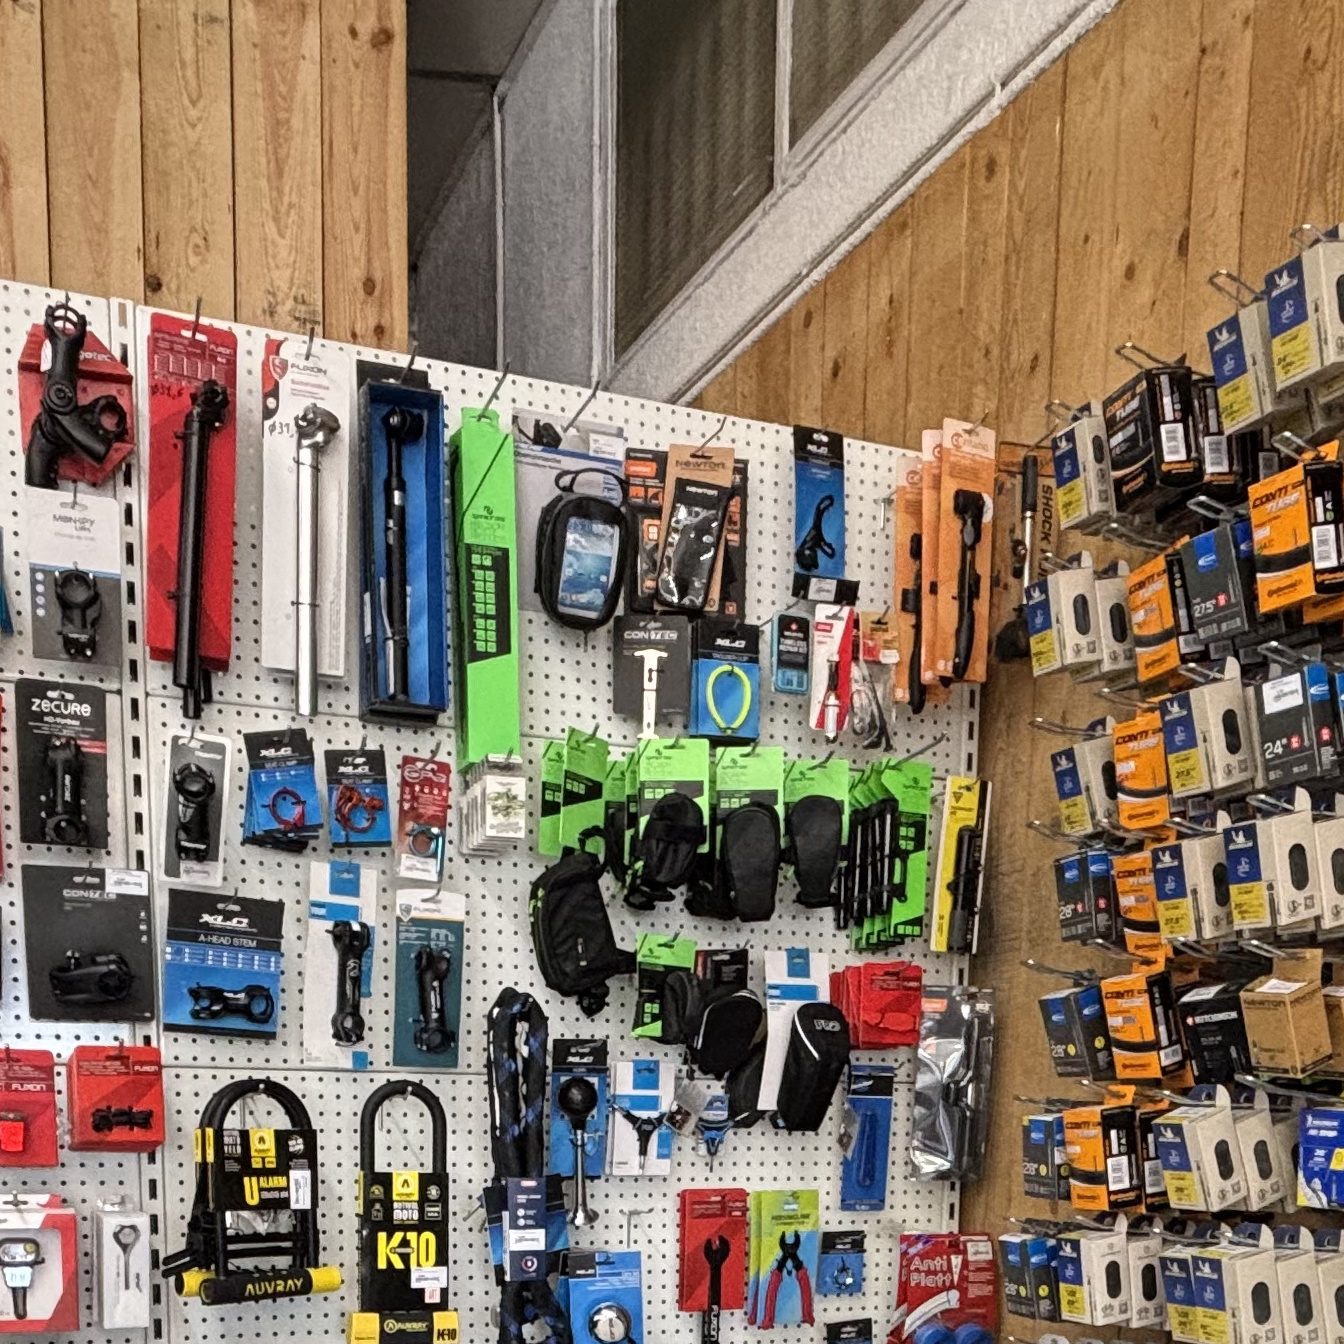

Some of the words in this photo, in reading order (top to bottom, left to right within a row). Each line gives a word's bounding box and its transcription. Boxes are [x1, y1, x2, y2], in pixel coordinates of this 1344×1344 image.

[268, 421, 295, 438] Ø31,
[623, 630, 678, 641] CONTEC
[199, 914, 249, 928] XLC
[198, 935, 231, 946] A-HEAD
[233, 938, 258, 948] STEM
[11, 1082, 47, 1093] FUXON
[910, 1255, 948, 1272] Anti
[244, 1278, 304, 1297] AUVRAY
[909, 1272, 953, 1288] Platt
